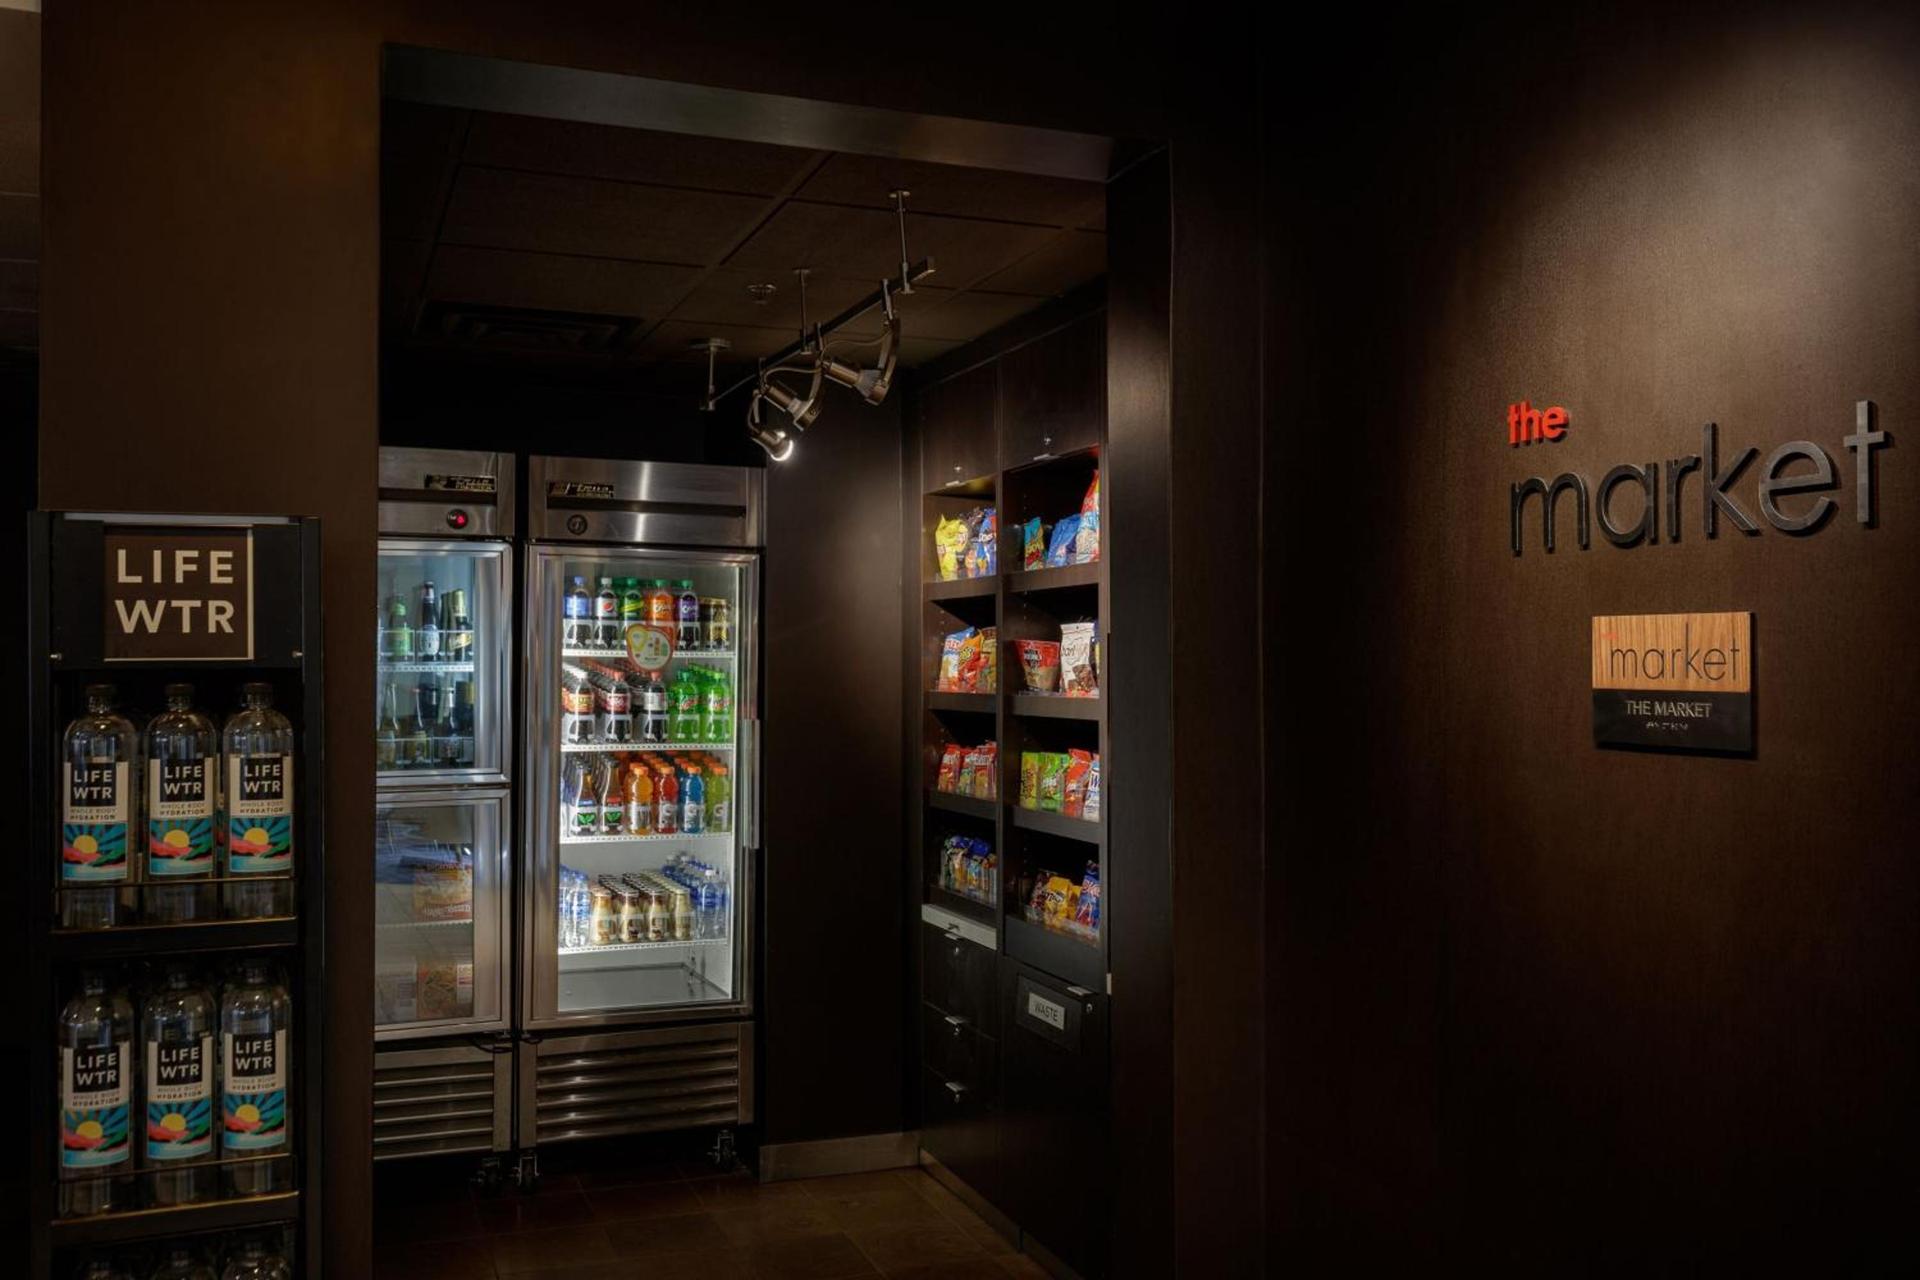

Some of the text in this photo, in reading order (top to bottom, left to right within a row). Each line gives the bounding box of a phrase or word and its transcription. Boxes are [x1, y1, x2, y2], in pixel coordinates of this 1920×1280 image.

[1507, 401, 1568, 446] the
[1511, 400, 1887, 556] market
[117, 549, 234, 584] LIFE
[114, 600, 235, 634] WTR
[1610, 621, 1740, 680] market
[1625, 700, 1712, 718] THE MARKET
[73, 769, 113, 783] LIFE
[164, 765, 202, 779] LIFE
[244, 764, 281, 778] LIFE
[73, 785, 113, 799] WTR
[163, 780, 202, 795] WTR
[243, 779, 281, 793] WTR
[1034, 1002, 1058, 1022] WASTE
[160, 1047, 200, 1062] LIFE
[235, 1040, 273, 1054] LIFE
[76, 1053, 117, 1069] LIFE
[235, 1056, 273, 1070] WTR
[76, 1070, 117, 1085] WTR
[160, 1064, 200, 1079] WTR
